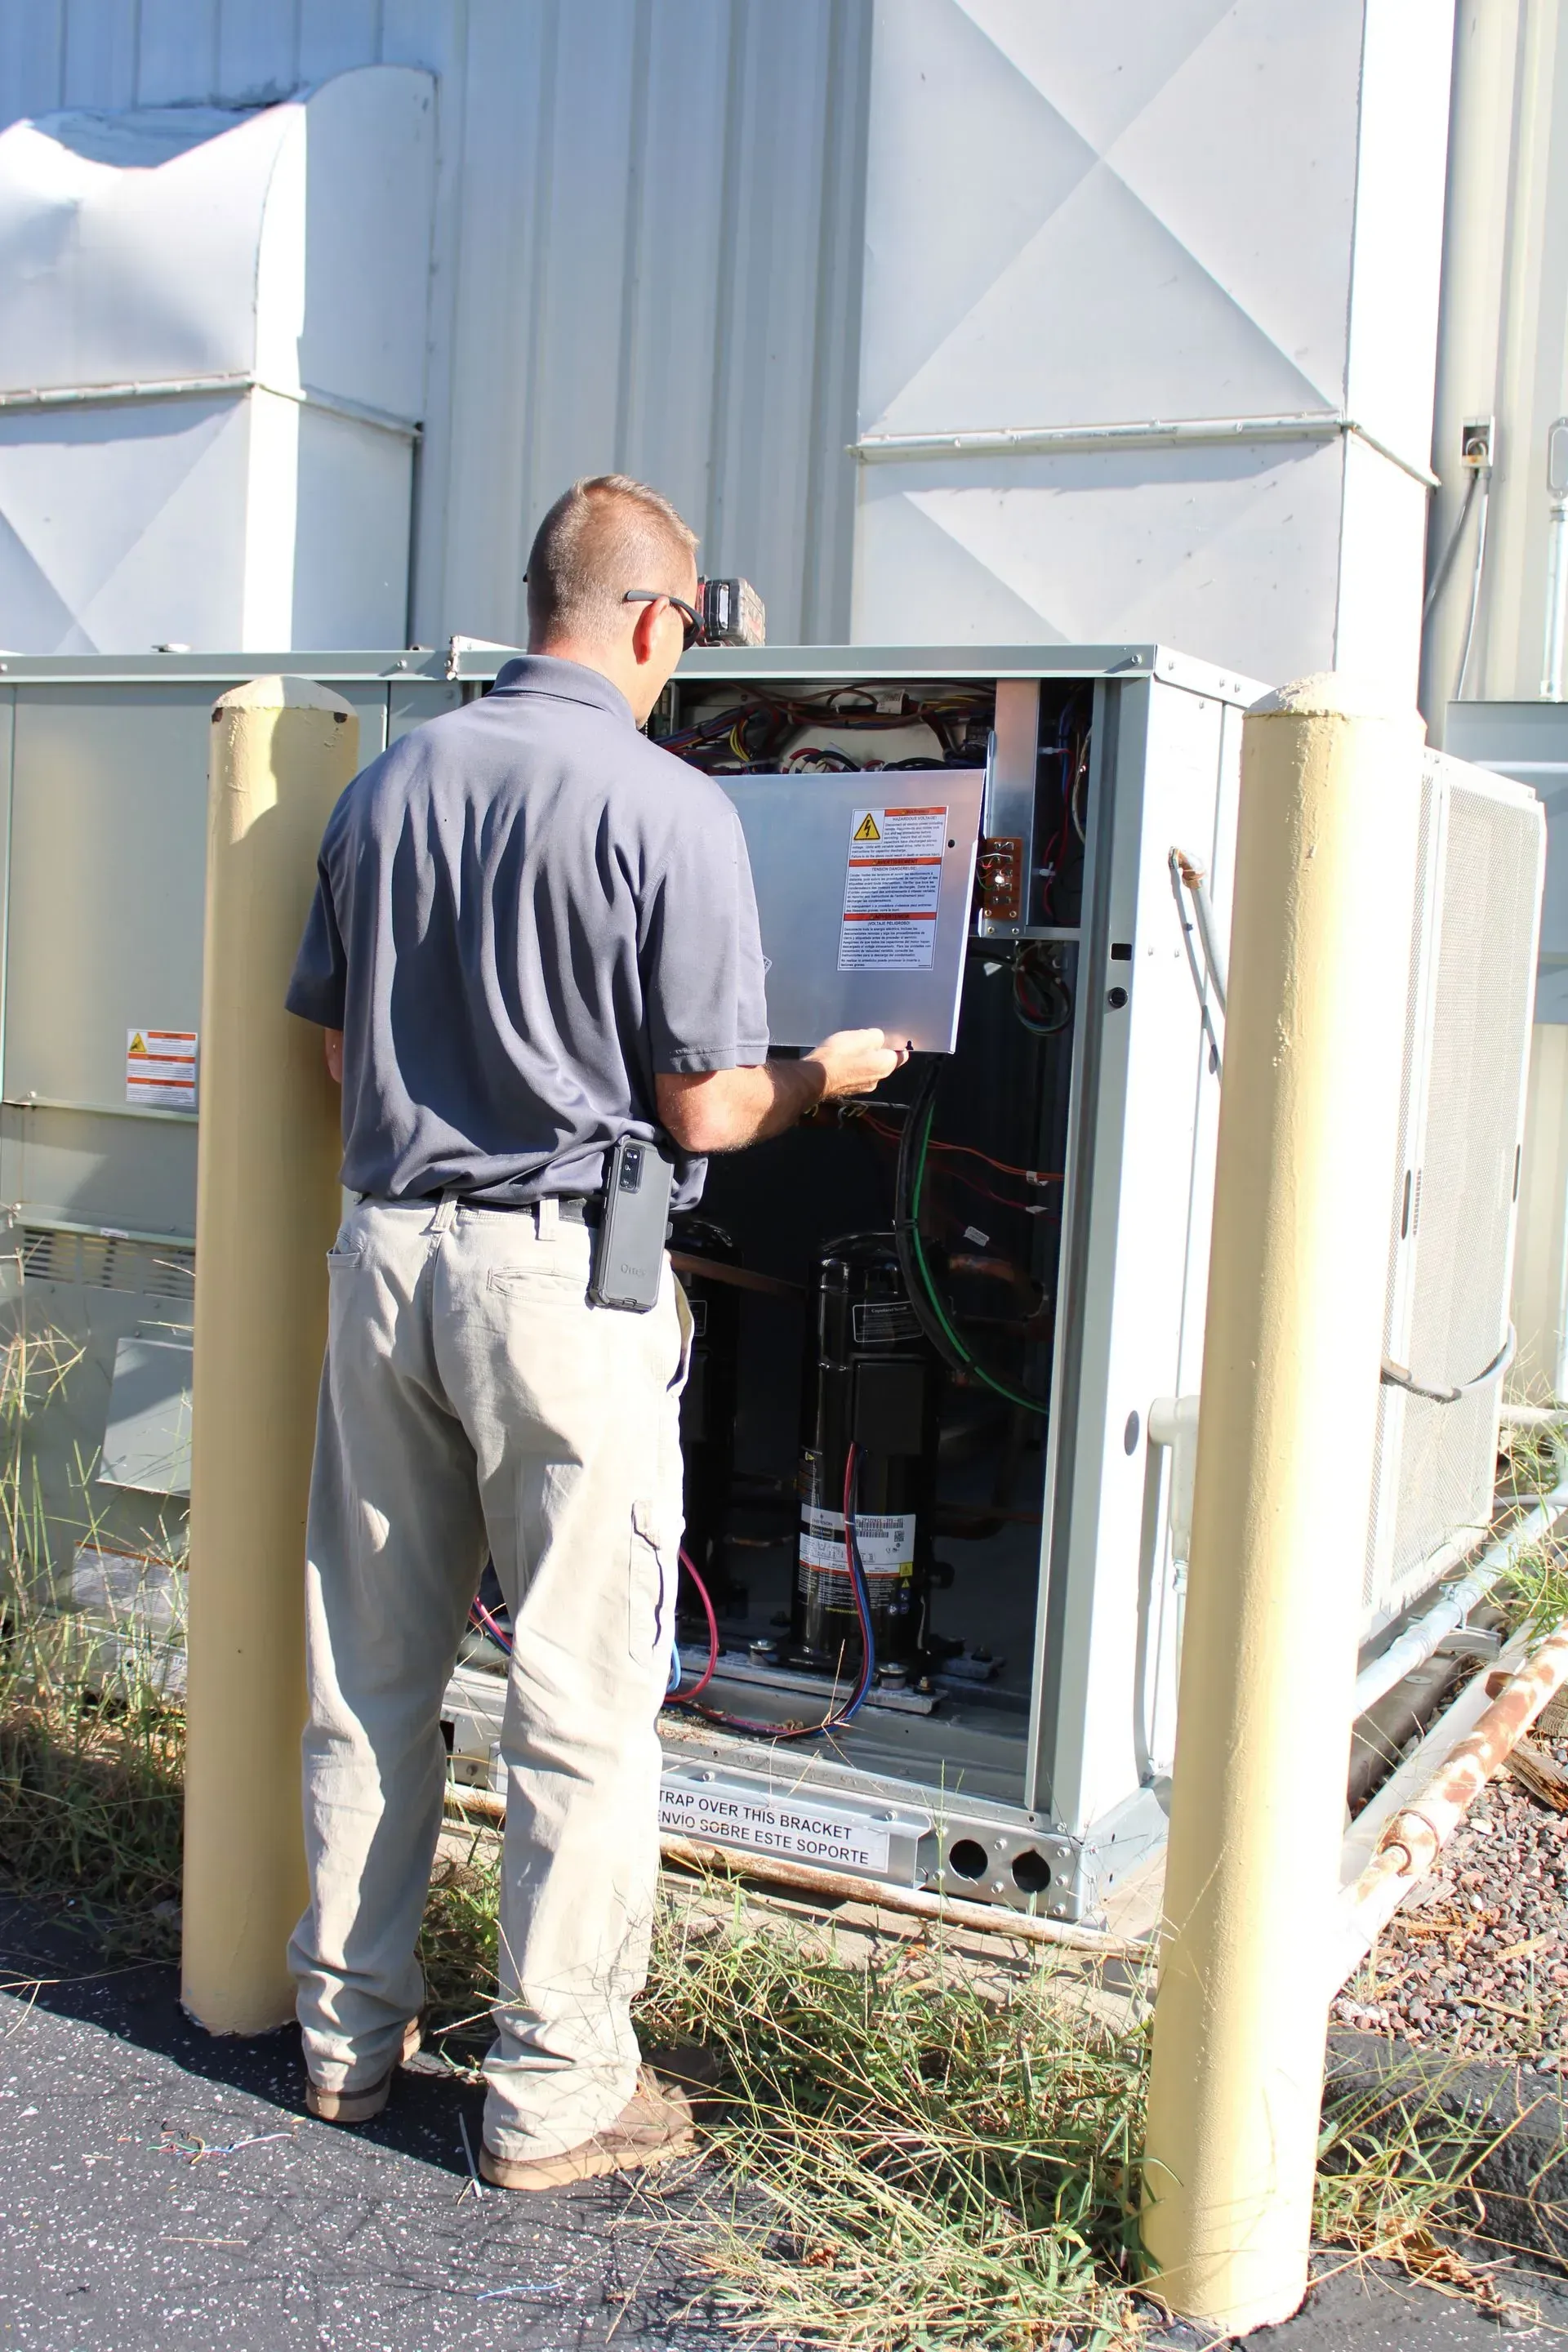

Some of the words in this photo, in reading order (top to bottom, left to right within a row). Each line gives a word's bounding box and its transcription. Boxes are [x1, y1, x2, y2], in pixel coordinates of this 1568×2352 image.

[660, 1790, 694, 1807] TRAP
[698, 1798, 738, 1817] OVER
[743, 1806, 775, 1824] THIS
[780, 1815, 852, 1839] BRACKET
[700, 1820, 750, 1840] SOBRE
[755, 1830, 792, 1849] ESTE
[796, 1838, 869, 1864] SOPORTE
